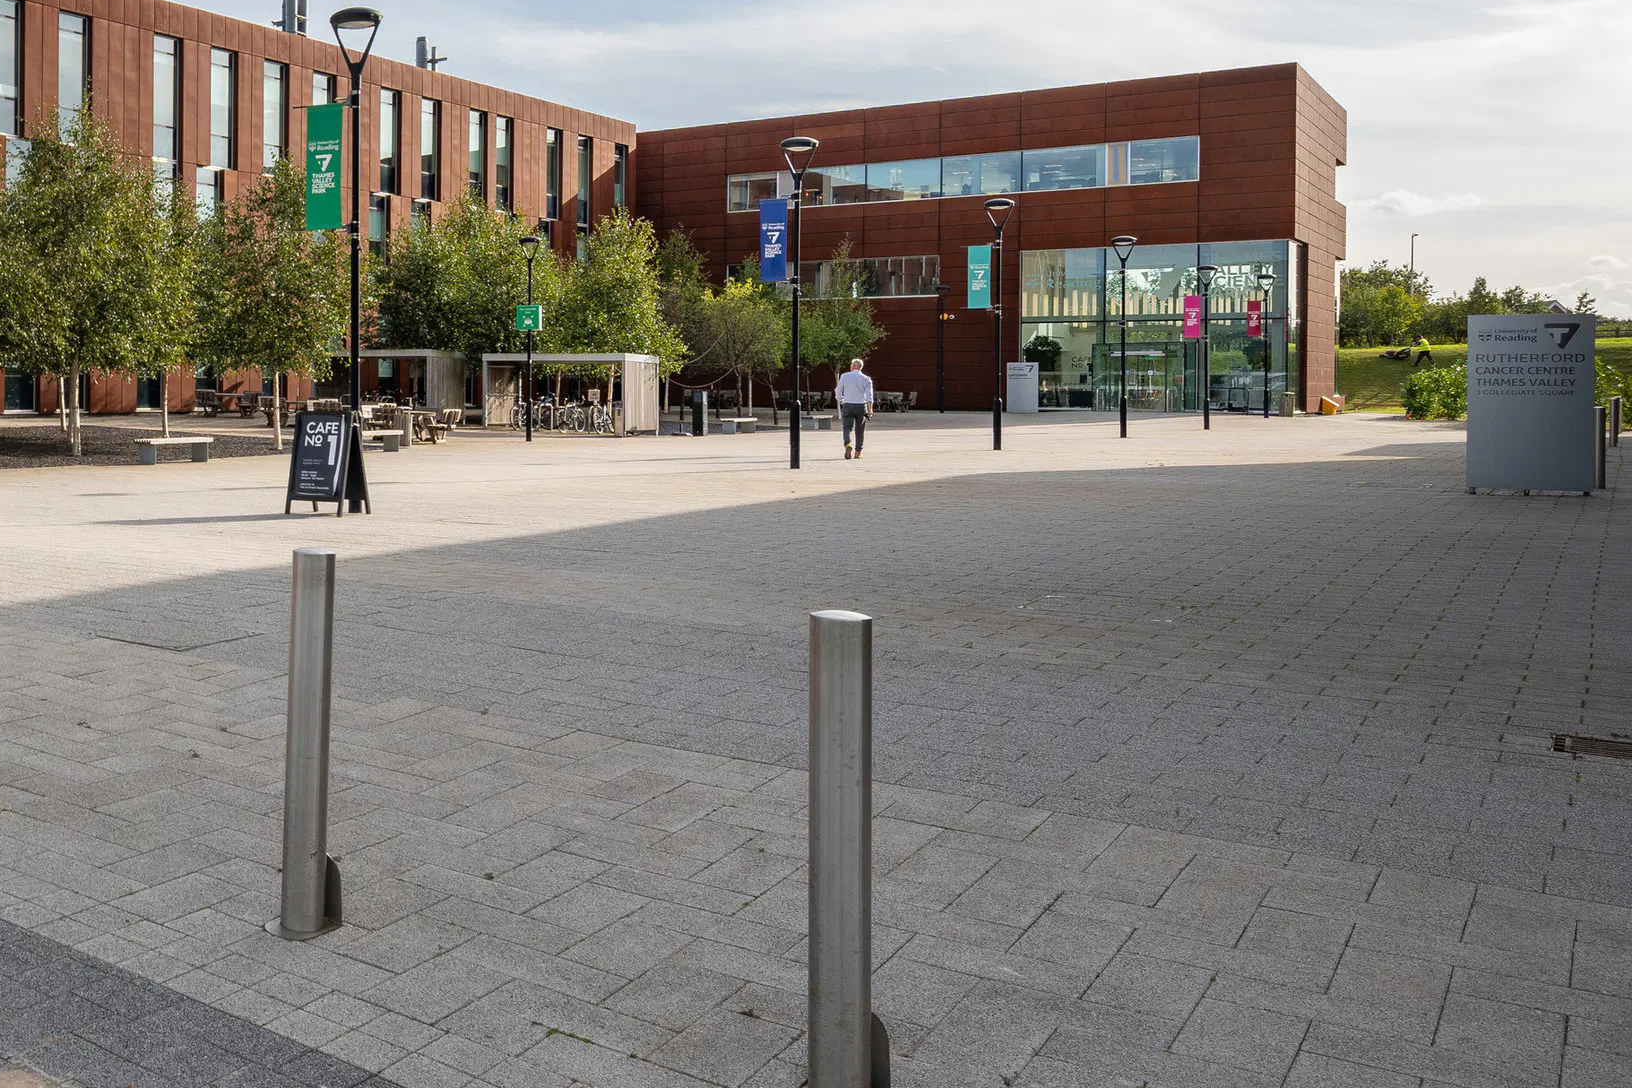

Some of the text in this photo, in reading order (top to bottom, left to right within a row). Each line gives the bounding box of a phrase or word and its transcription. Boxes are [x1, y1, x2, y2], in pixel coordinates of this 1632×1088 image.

[1494, 334, 1538, 343] Reading
[1475, 353, 1586, 363] RUTHERFORD
[1475, 366, 1576, 375] CANCER CENTRE
[1475, 378, 1577, 387] THAMES VALLEY
[306, 421, 339, 434] CAFE
[327, 434, 338, 466] 1
